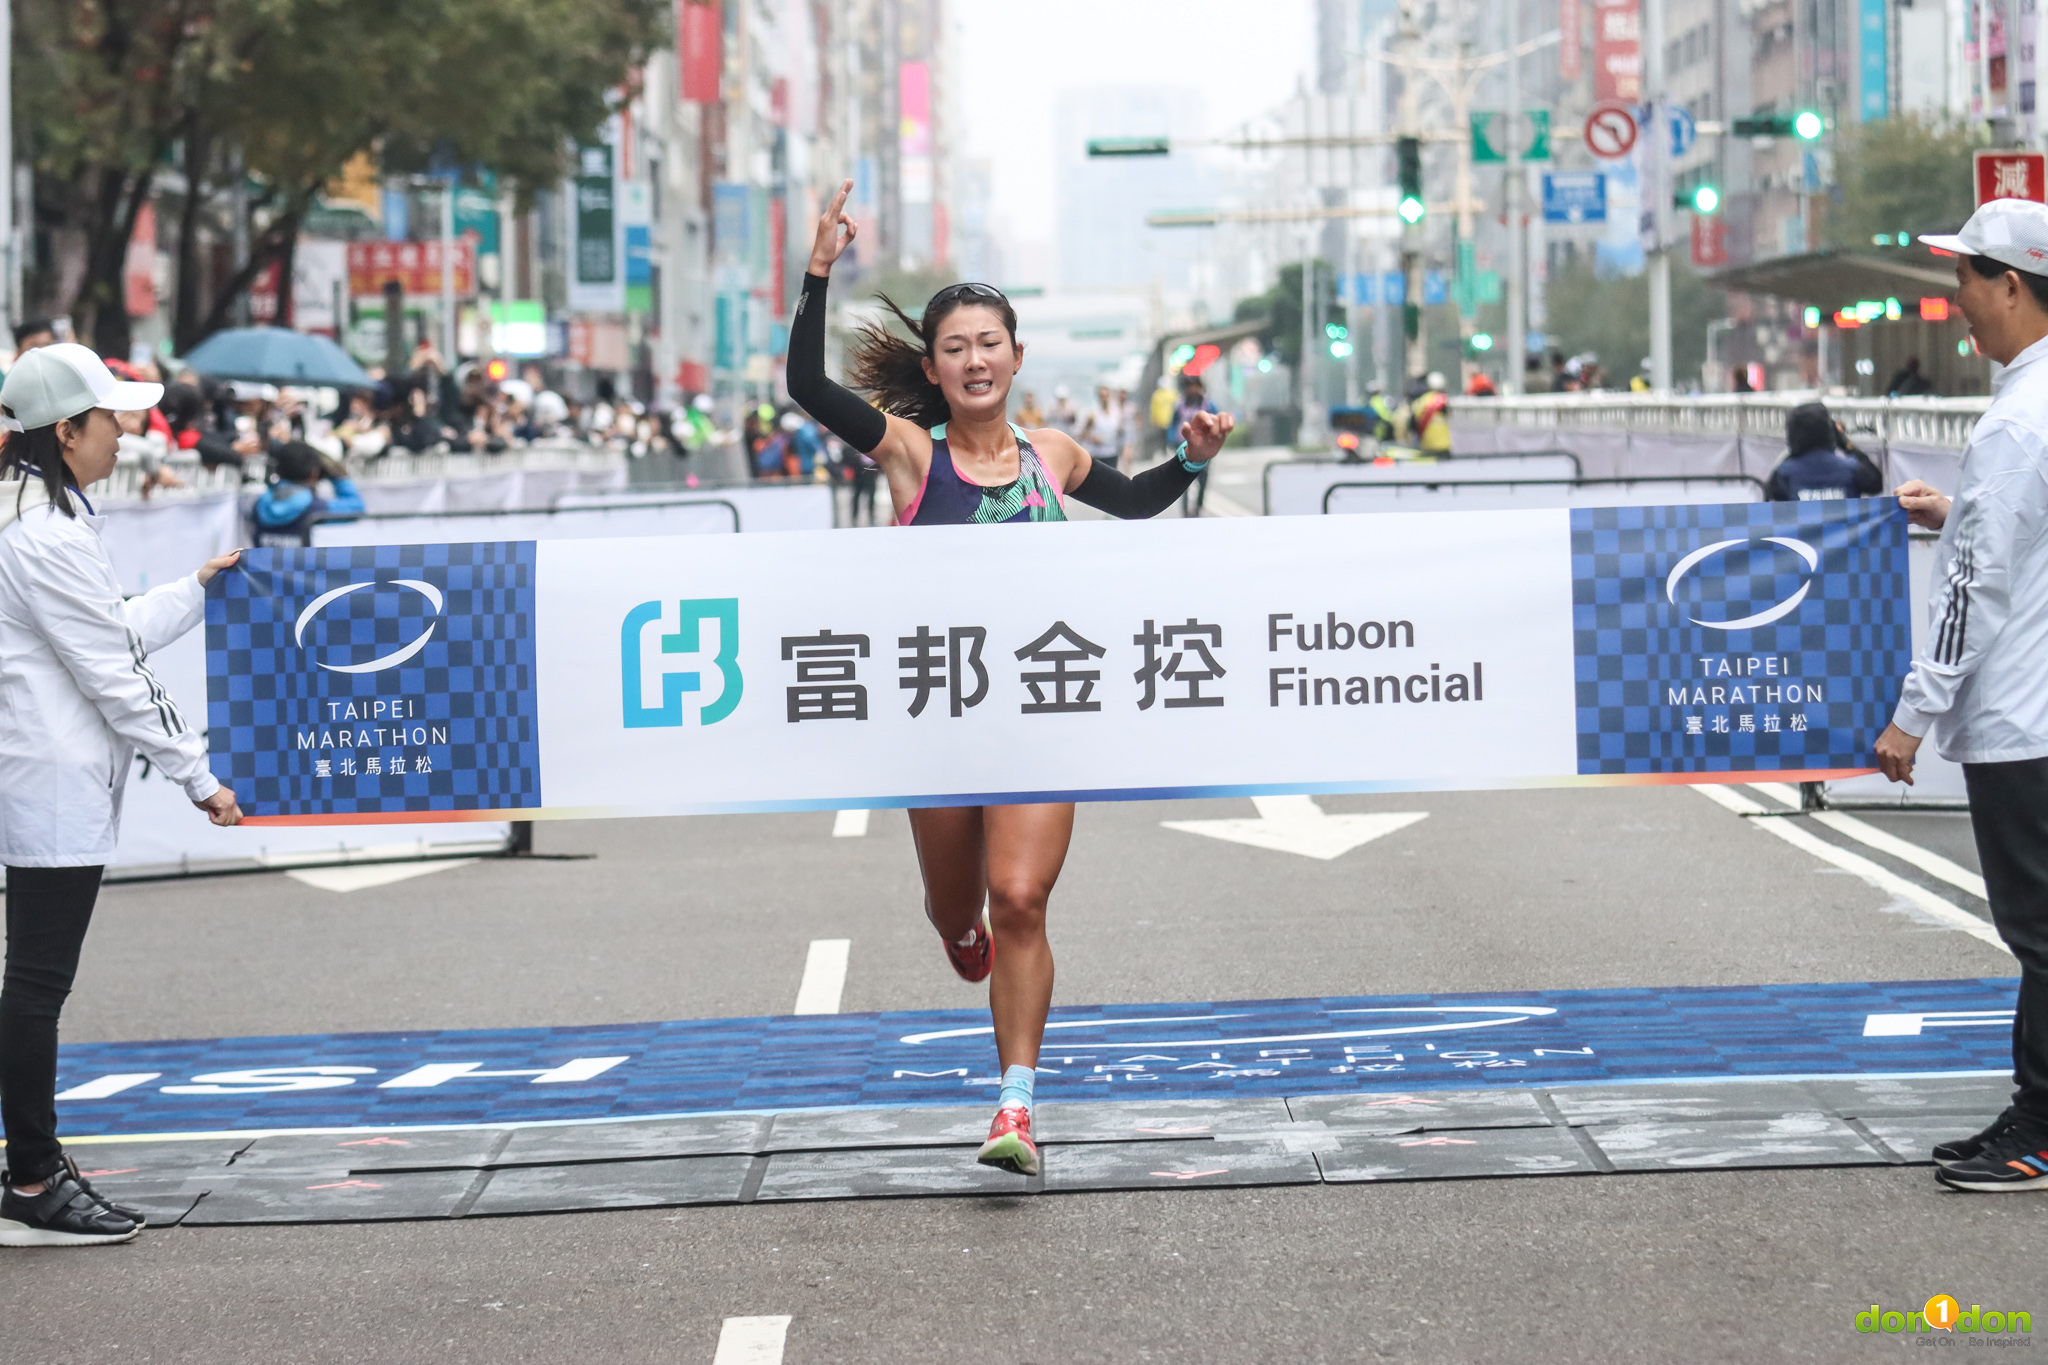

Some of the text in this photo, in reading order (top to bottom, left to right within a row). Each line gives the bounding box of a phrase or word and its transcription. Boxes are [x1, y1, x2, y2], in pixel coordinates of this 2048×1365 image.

[1993, 158, 2030, 198] 減
[1267, 611, 1415, 652] Fubon
[781, 617, 1227, 723] 富邦金控
[1699, 656, 1789, 677] TAIPEI
[1268, 661, 1483, 708] Financial
[1668, 684, 1822, 706] MARATHON
[327, 699, 414, 721] TAIPEI
[1685, 713, 1808, 735] 臺北馬拉松
[297, 726, 447, 750] MARATHON
[314, 755, 433, 778] 臺北馬拉松
[54, 1055, 631, 1101] ISH
